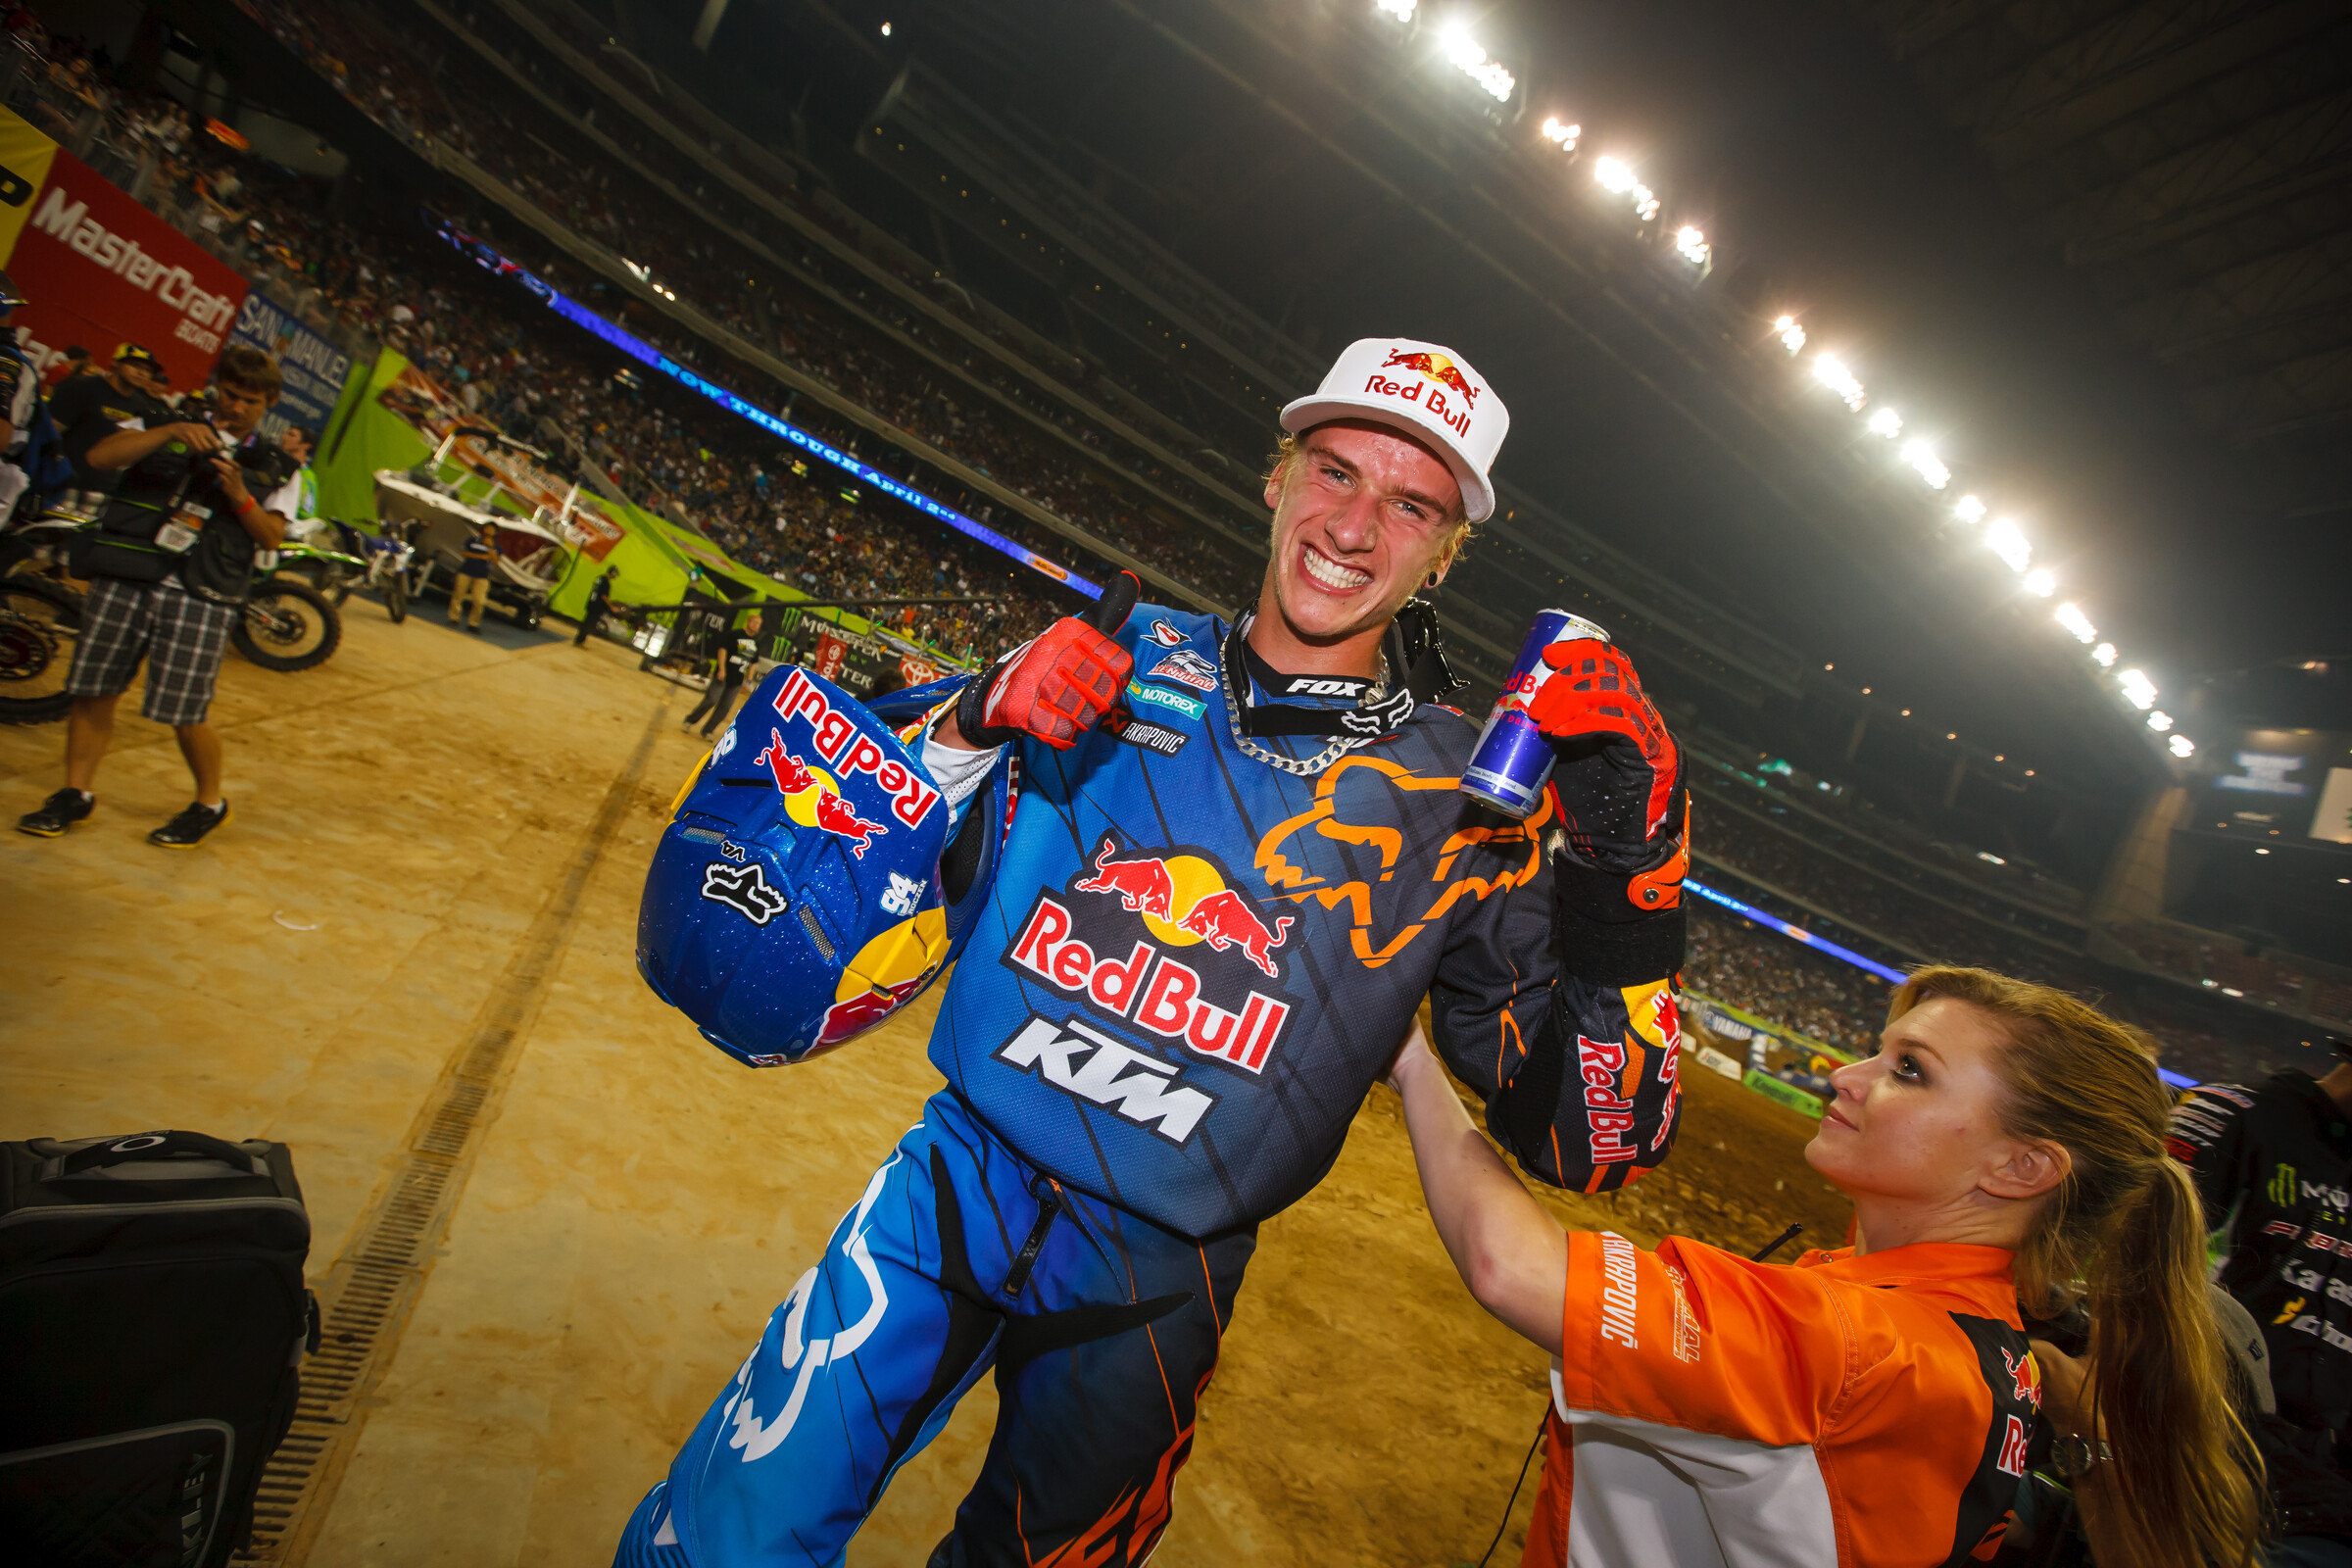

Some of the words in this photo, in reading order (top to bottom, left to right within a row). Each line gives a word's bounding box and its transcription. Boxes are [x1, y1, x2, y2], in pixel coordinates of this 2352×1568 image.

[32, 187, 235, 329] MasterCraft
[235, 294, 284, 346] SAN
[658, 357, 725, 399] NOW
[729, 396, 862, 474] THROUGH
[865, 470, 922, 507] April
[1364, 375, 1424, 401] Red
[1426, 389, 1471, 438] Bull
[772, 668, 858, 764] Bull
[1142, 688, 1199, 715] MOTOREX
[1286, 677, 1367, 699] FOX
[836, 733, 941, 829] Red
[880, 868, 918, 916] 94
[1010, 897, 1156, 1018] Red
[1133, 956, 1291, 1075] Bull
[1001, 1018, 1213, 1144] KTM
[1578, 1034, 1634, 1109] Red
[1587, 1109, 1638, 1164] Bull
[1996, 1414, 2028, 1478] Re
